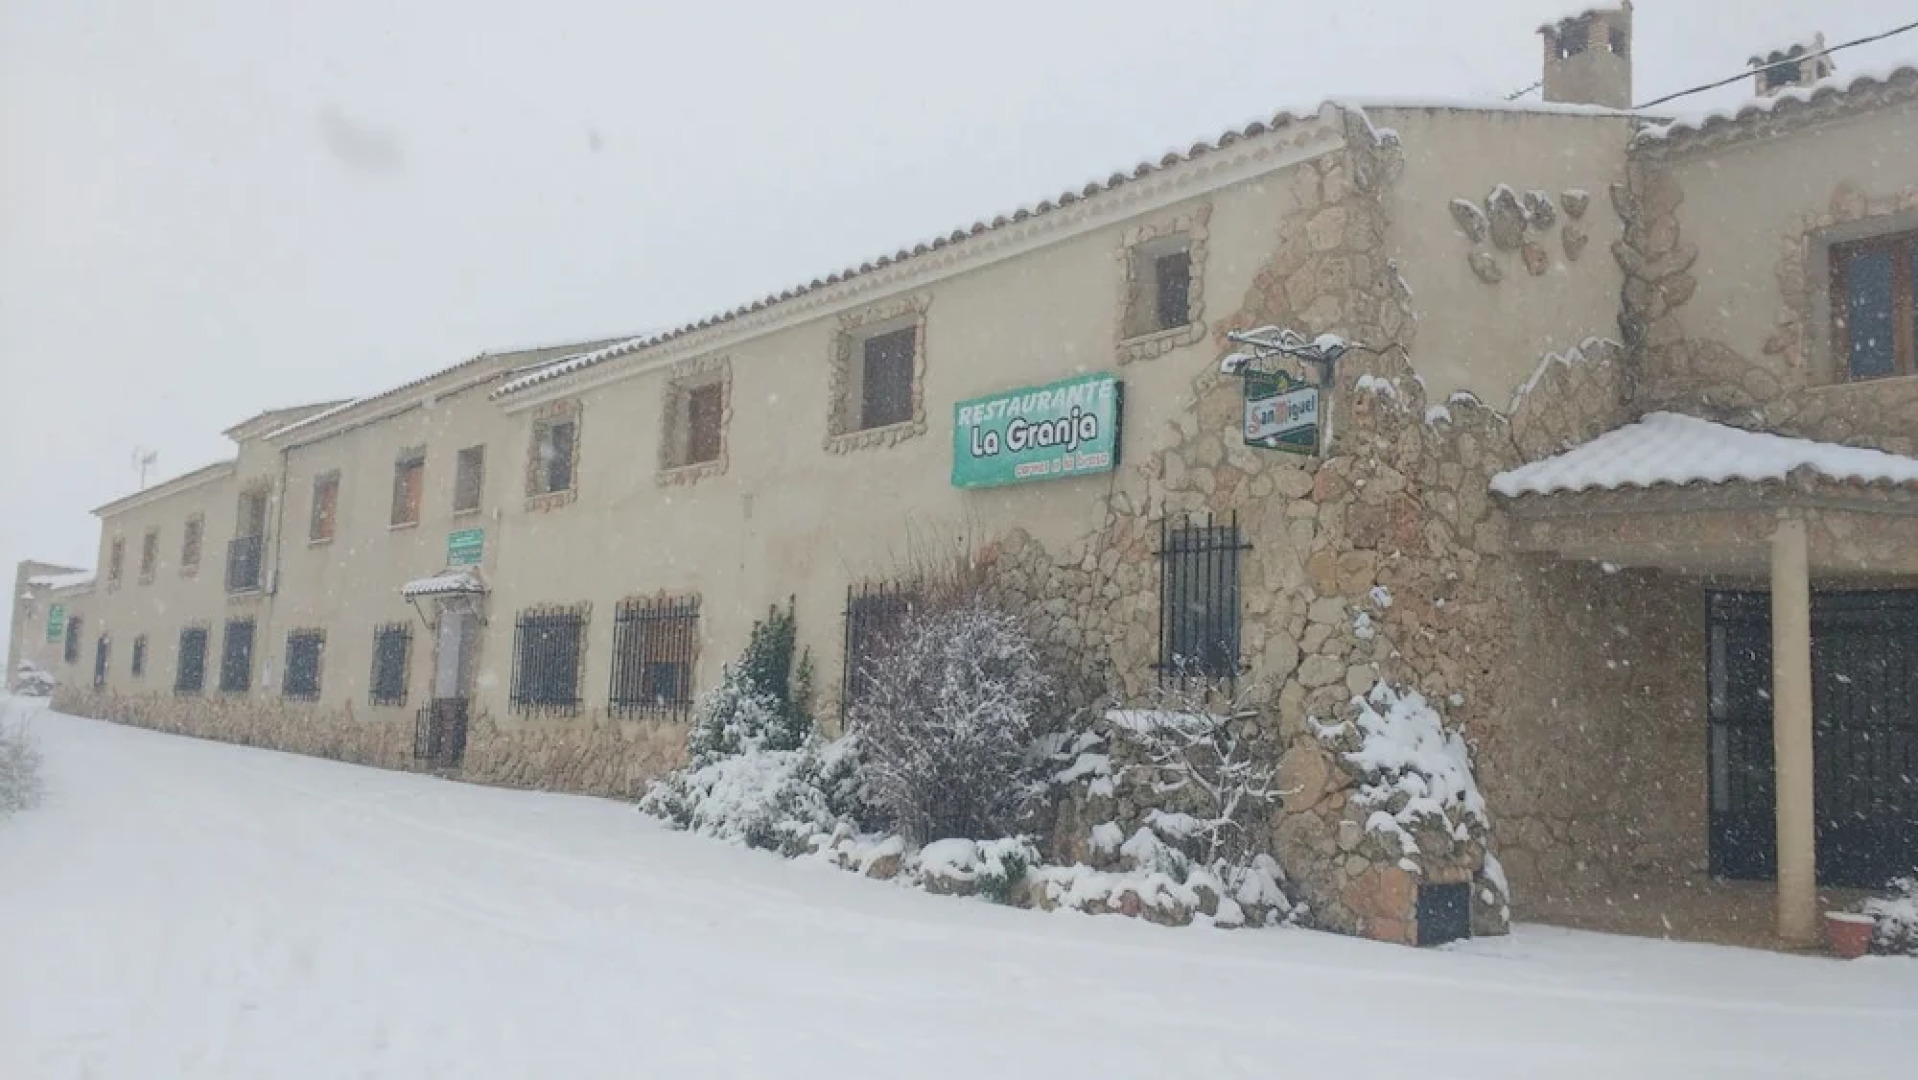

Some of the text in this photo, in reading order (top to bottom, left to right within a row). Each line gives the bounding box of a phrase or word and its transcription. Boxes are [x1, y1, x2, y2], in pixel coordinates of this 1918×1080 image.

[959, 378, 1114, 426] RESTAURANTE
[1247, 406, 1274, 434] San
[970, 405, 1098, 458] La Granja
